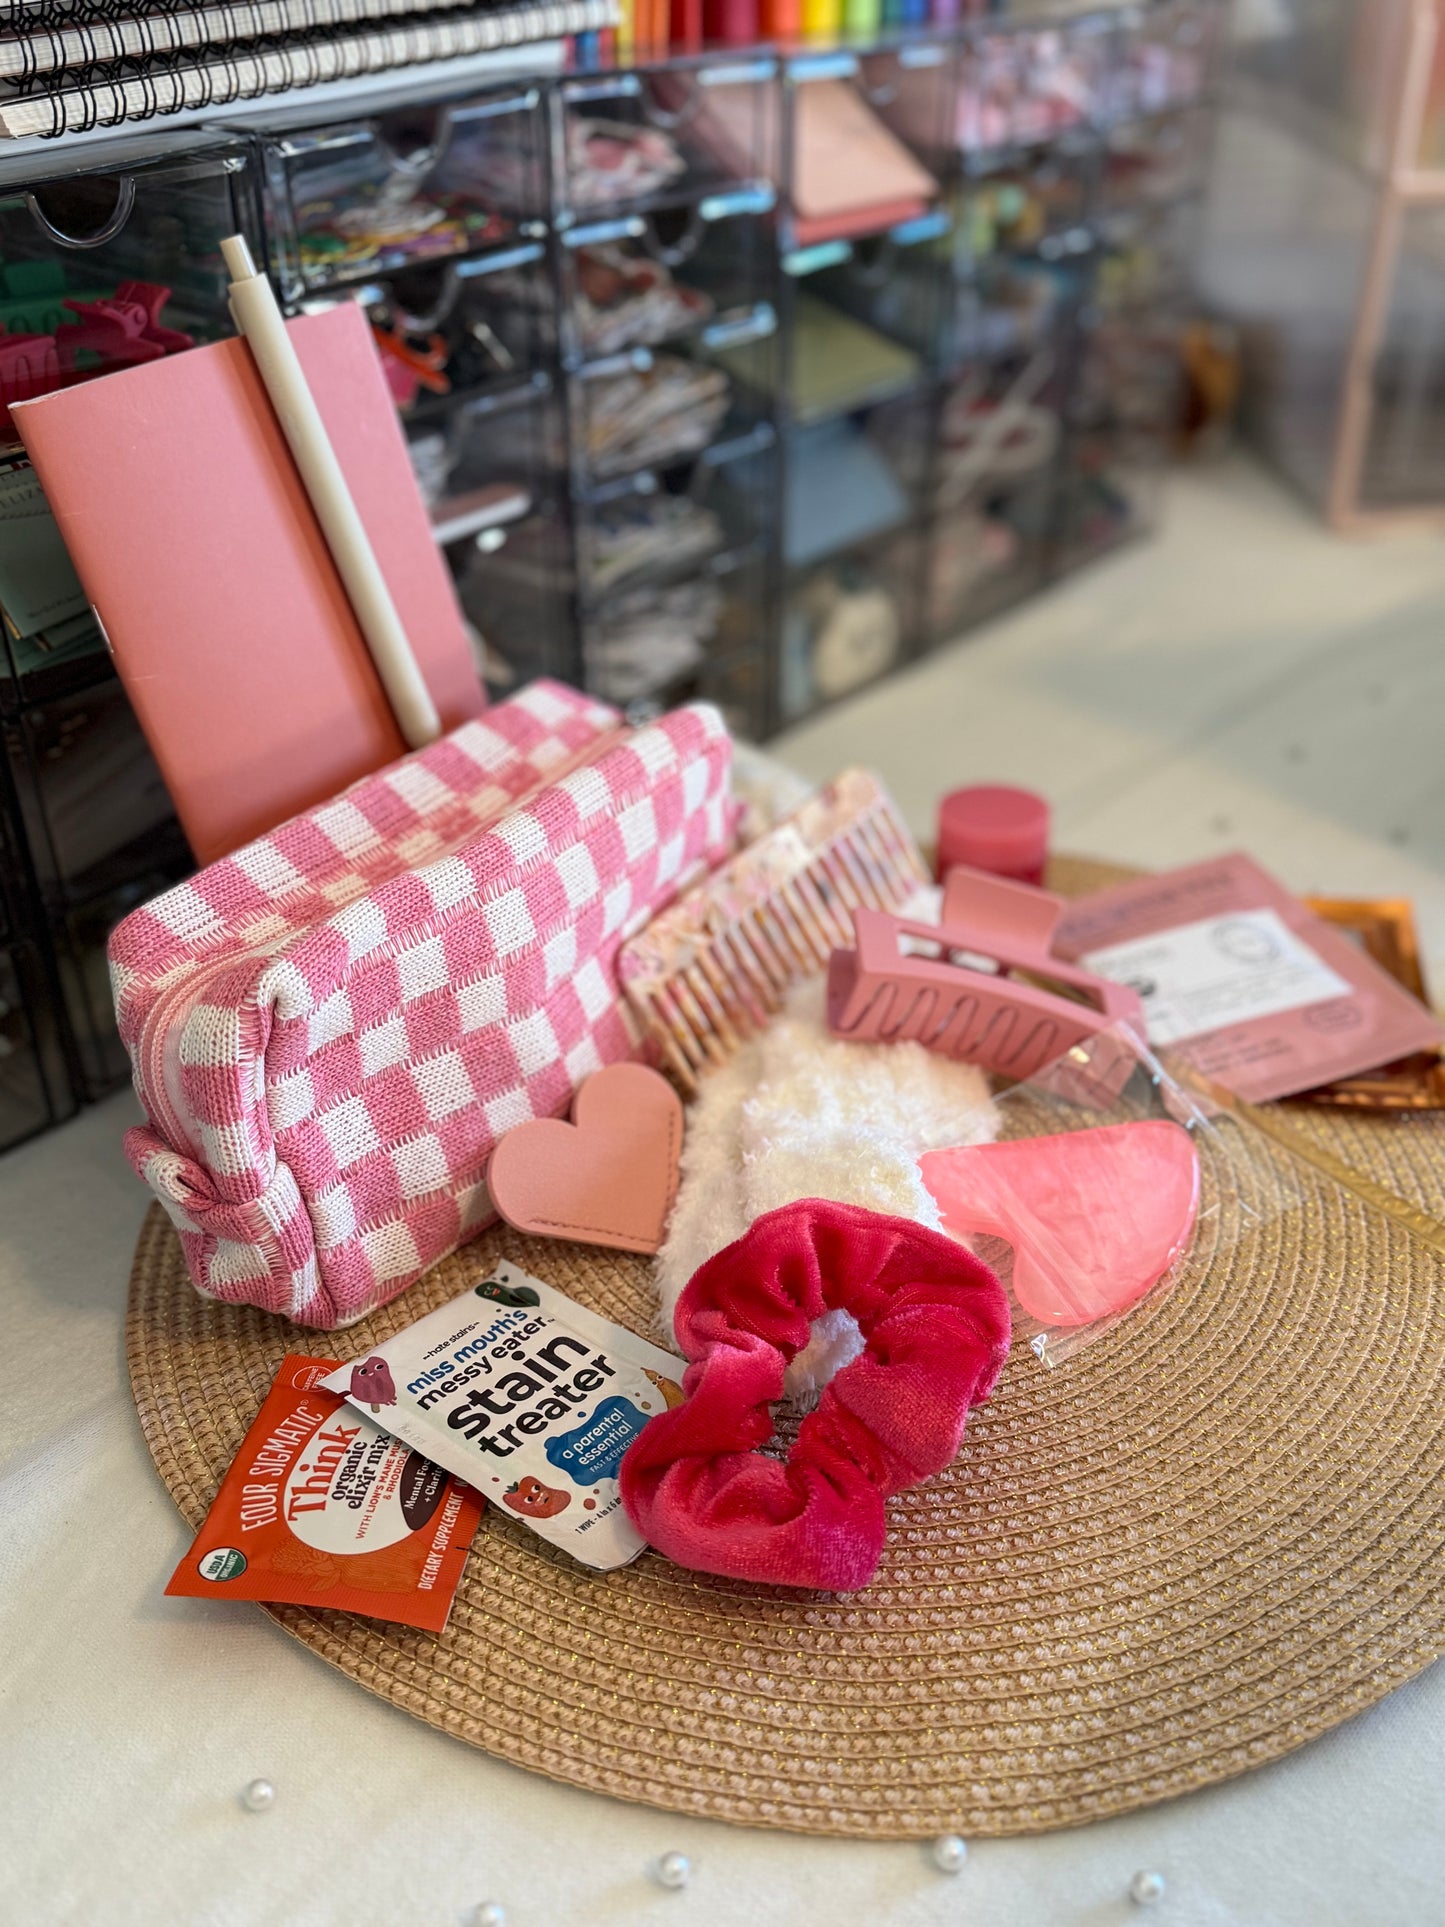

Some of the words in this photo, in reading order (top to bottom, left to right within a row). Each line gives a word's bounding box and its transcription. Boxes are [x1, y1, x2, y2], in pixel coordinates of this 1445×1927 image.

[407, 1360, 455, 1395] miss
[453, 1309, 528, 1364] mouth's
[416, 1355, 493, 1411] messy
[446, 1336, 591, 1441] stain
[477, 1354, 617, 1458] treater
[562, 1449, 574, 1459] a
[573, 1407, 625, 1455] parental
[578, 1419, 633, 1465] essential
[287, 1424, 363, 1522] Think
[331, 1441, 368, 1501] organic
[347, 1466, 377, 1510] elixir
[367, 1434, 391, 1465] mix
[386, 1448, 410, 1493] RHODIOLA
[589, 1459, 606, 1473] FAST
[605, 1454, 612, 1462] &
[240, 1482, 280, 1532] FOUR
[355, 1514, 373, 1540] WITH
[366, 1485, 385, 1513] LION'S
[378, 1458, 395, 1483] MANE
[403, 1477, 425, 1510] Mental
[206, 1554, 226, 1574] USDA
[417, 1551, 444, 1591] DIETARY
[431, 1491, 465, 1551] SUPPLEMENT
